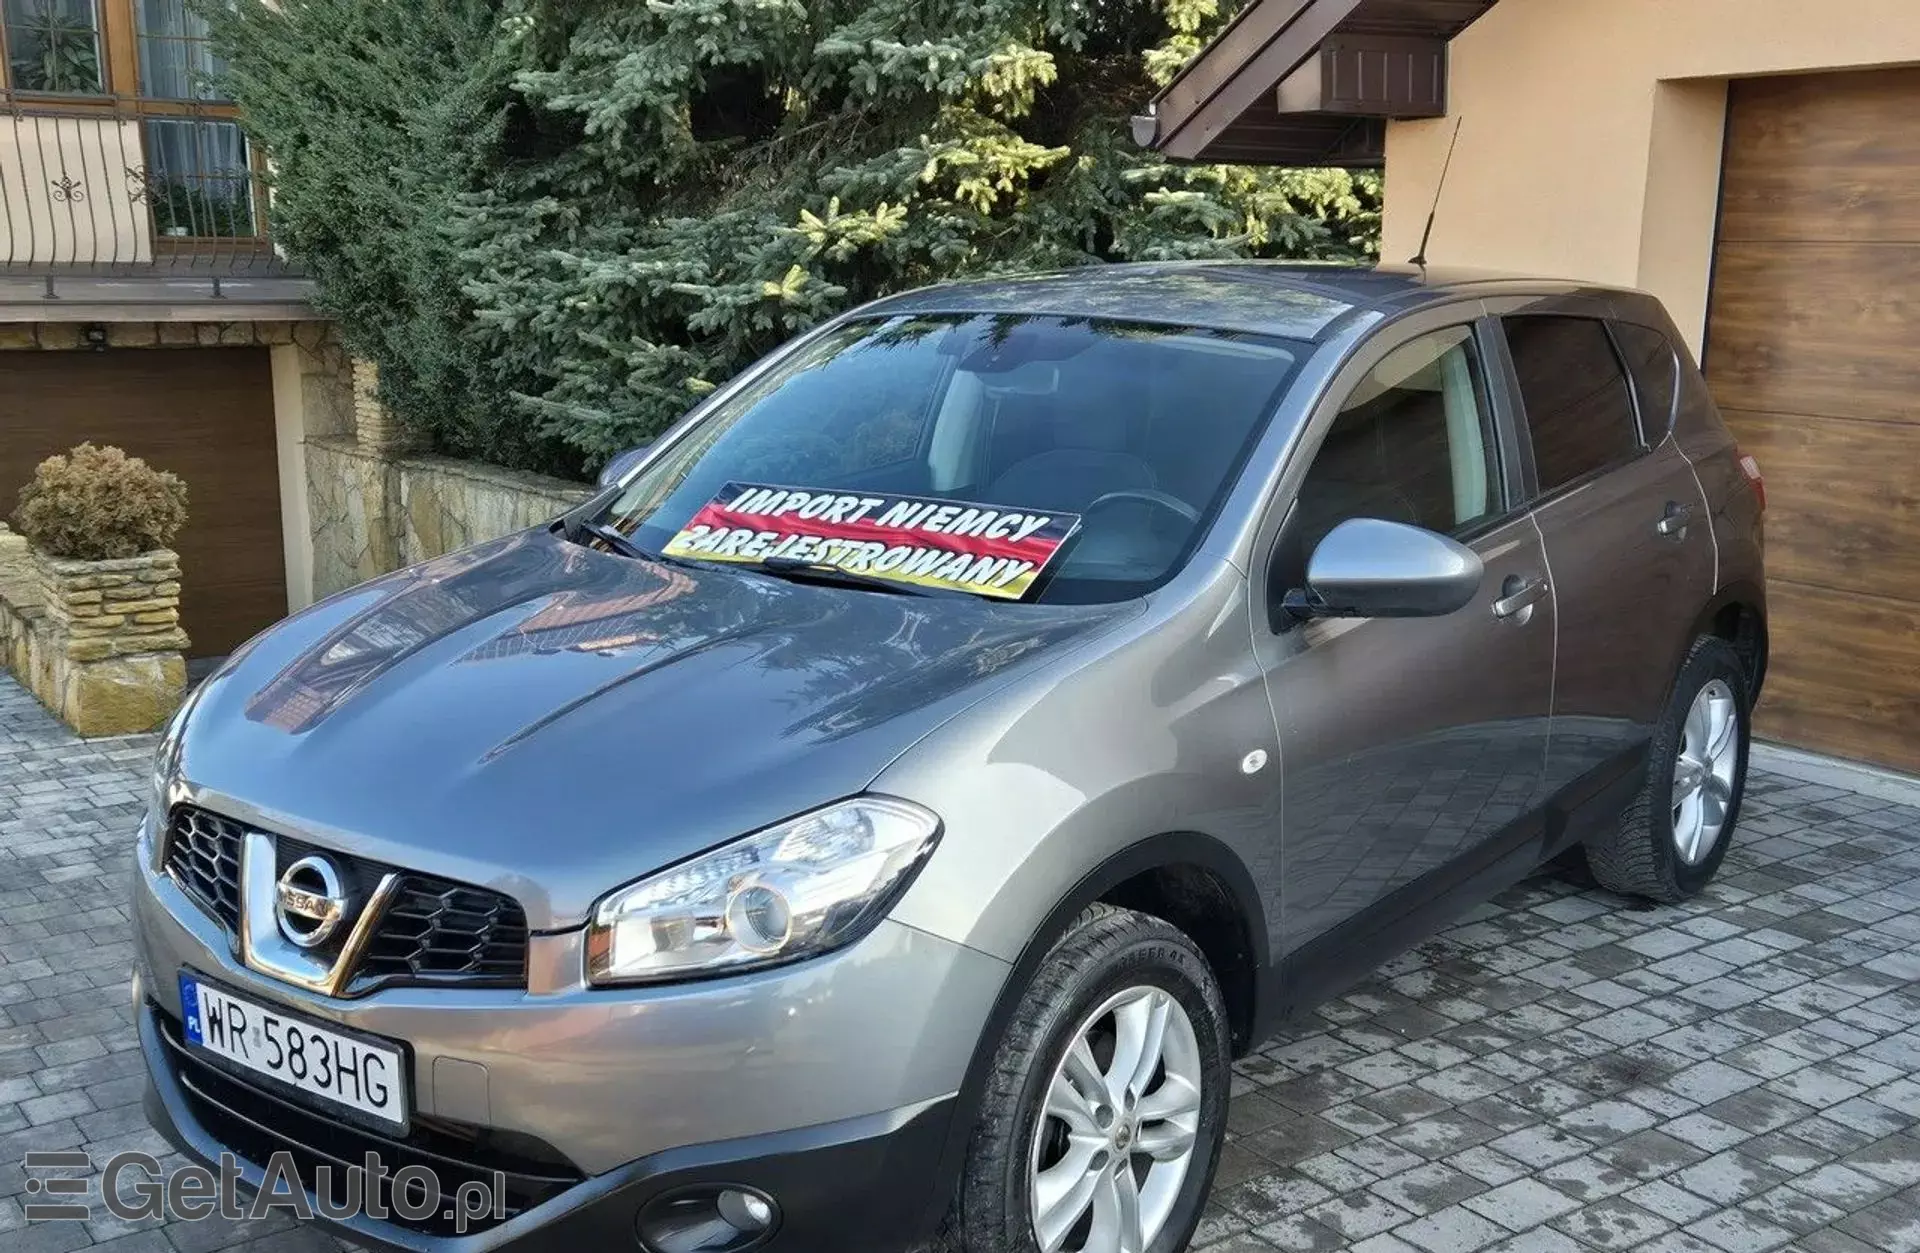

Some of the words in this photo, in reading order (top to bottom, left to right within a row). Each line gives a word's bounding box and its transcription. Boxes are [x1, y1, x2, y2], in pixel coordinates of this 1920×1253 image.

[725, 487, 884, 524] IMPORT
[880, 501, 1051, 543] NIEMCY
[674, 525, 1035, 588] ZAREJESTROWANY
[187, 1015, 201, 1034] PL
[203, 992, 249, 1059] WR
[263, 1015, 389, 1109] 583HG
